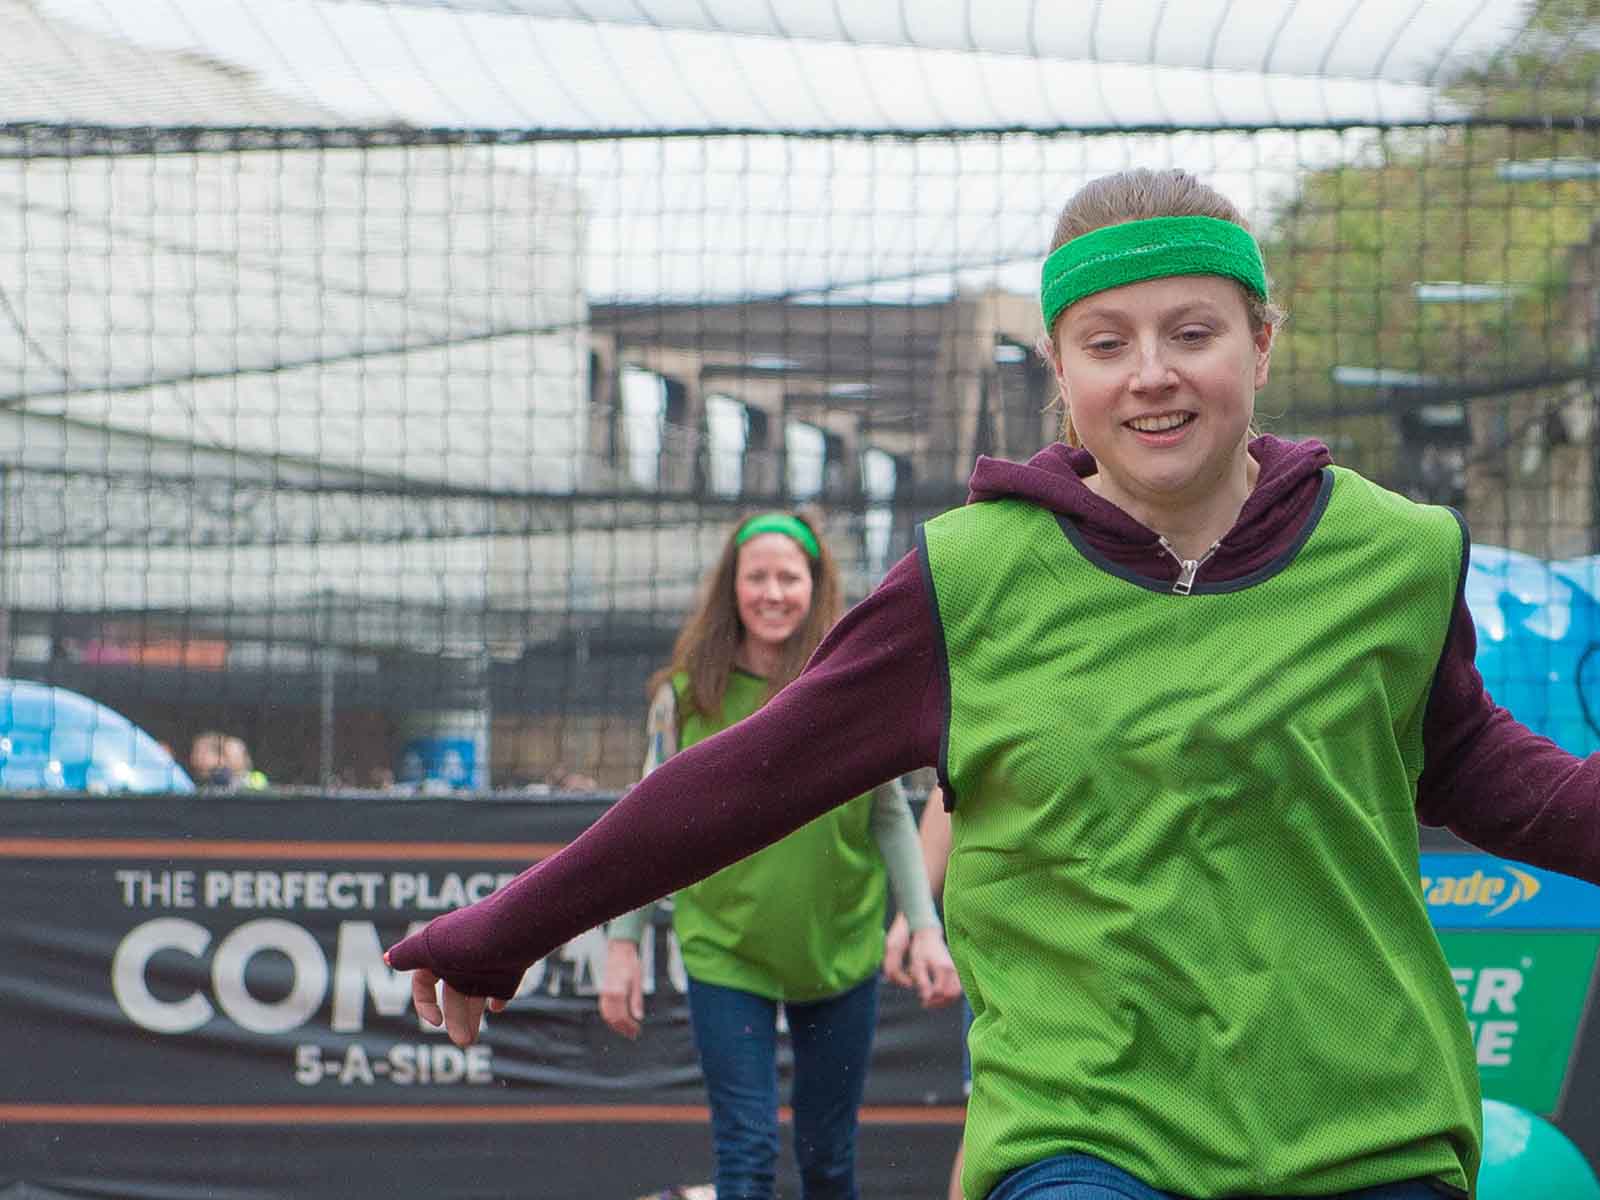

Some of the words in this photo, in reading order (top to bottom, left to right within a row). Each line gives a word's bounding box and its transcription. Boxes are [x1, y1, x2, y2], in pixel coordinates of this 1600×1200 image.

[115, 870, 196, 908] THE
[204, 871, 382, 910] PERFECT
[296, 1044, 493, 1086] 5-A-SIDE
